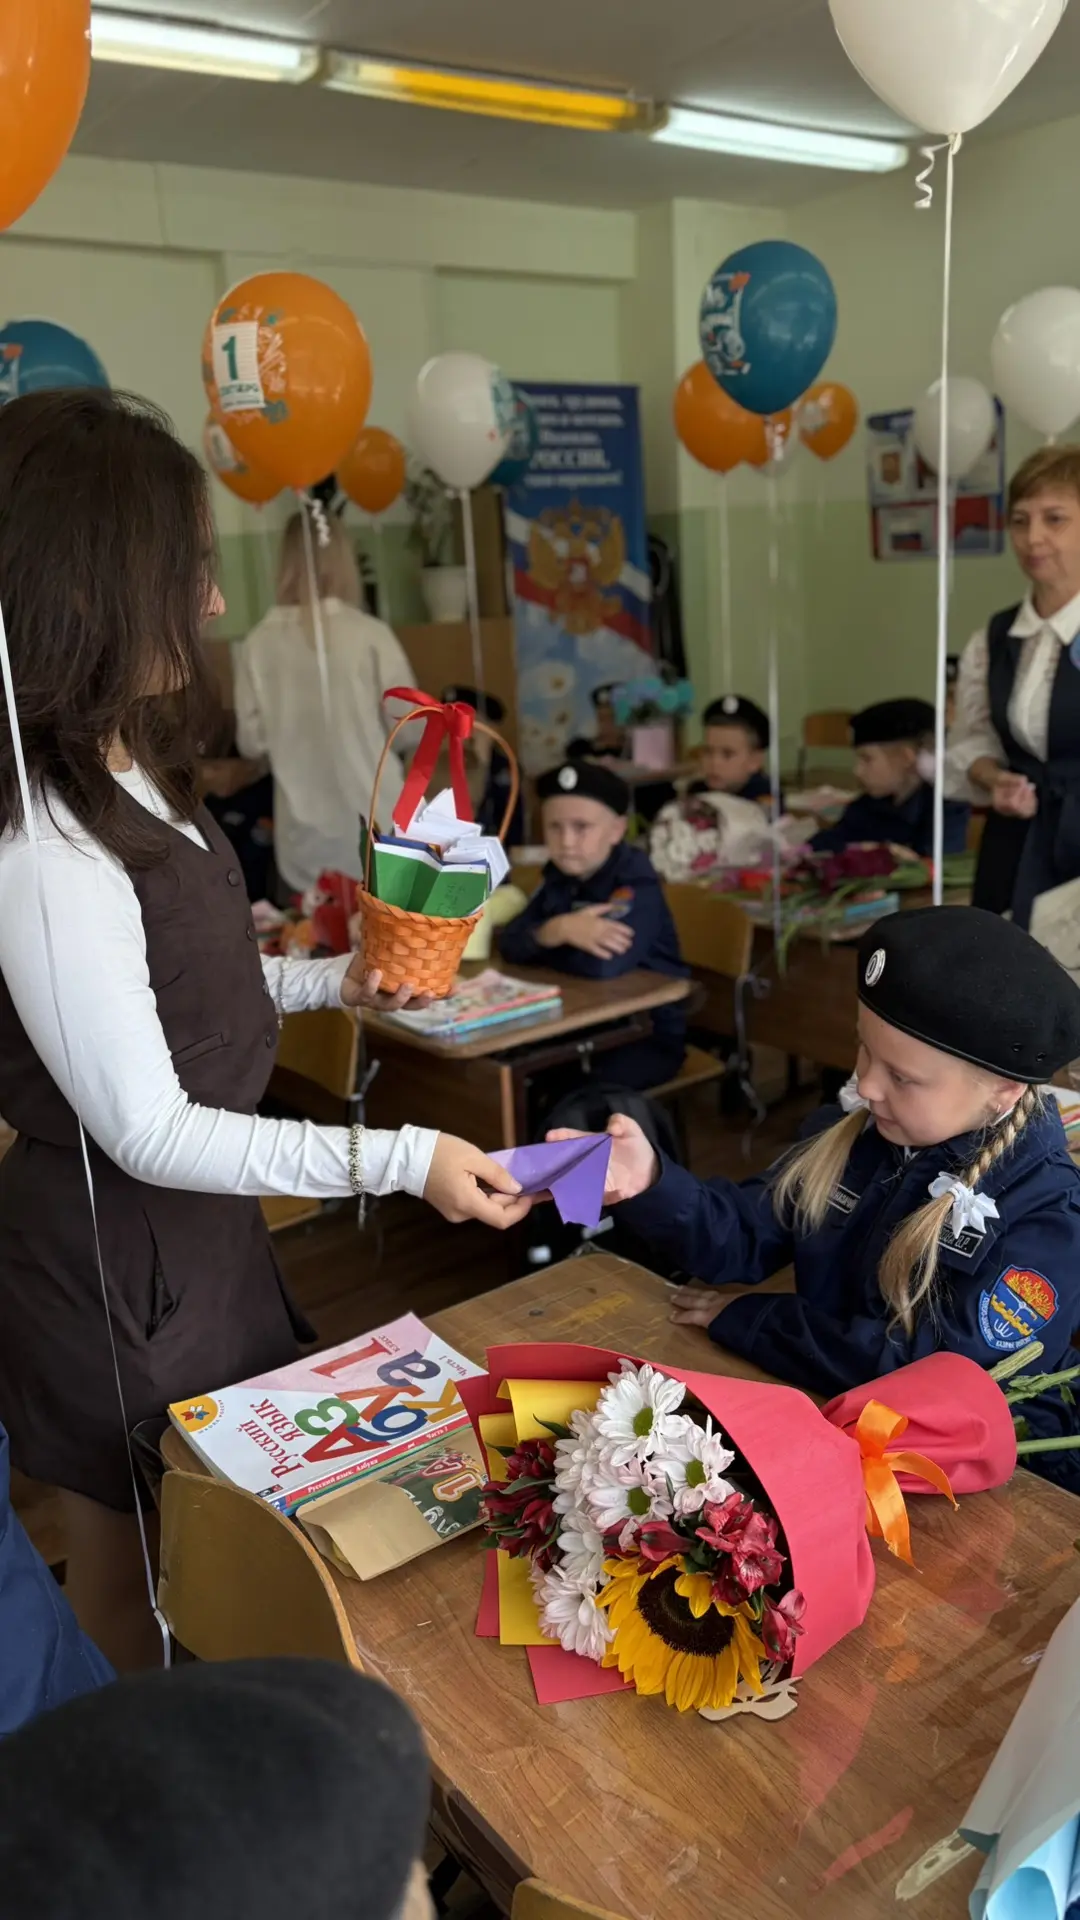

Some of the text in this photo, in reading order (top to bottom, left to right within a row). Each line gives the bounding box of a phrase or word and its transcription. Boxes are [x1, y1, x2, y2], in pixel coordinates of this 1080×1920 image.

[222, 335, 238, 380] 1
[310, 1338, 392, 1379] 1
[446, 1357, 468, 1377] Часть
[236, 1420, 305, 1479] Русский
[426, 1429, 444, 1440] Часть
[307, 1478, 336, 1494] Русский
[355, 1458, 379, 1473] Азбука
